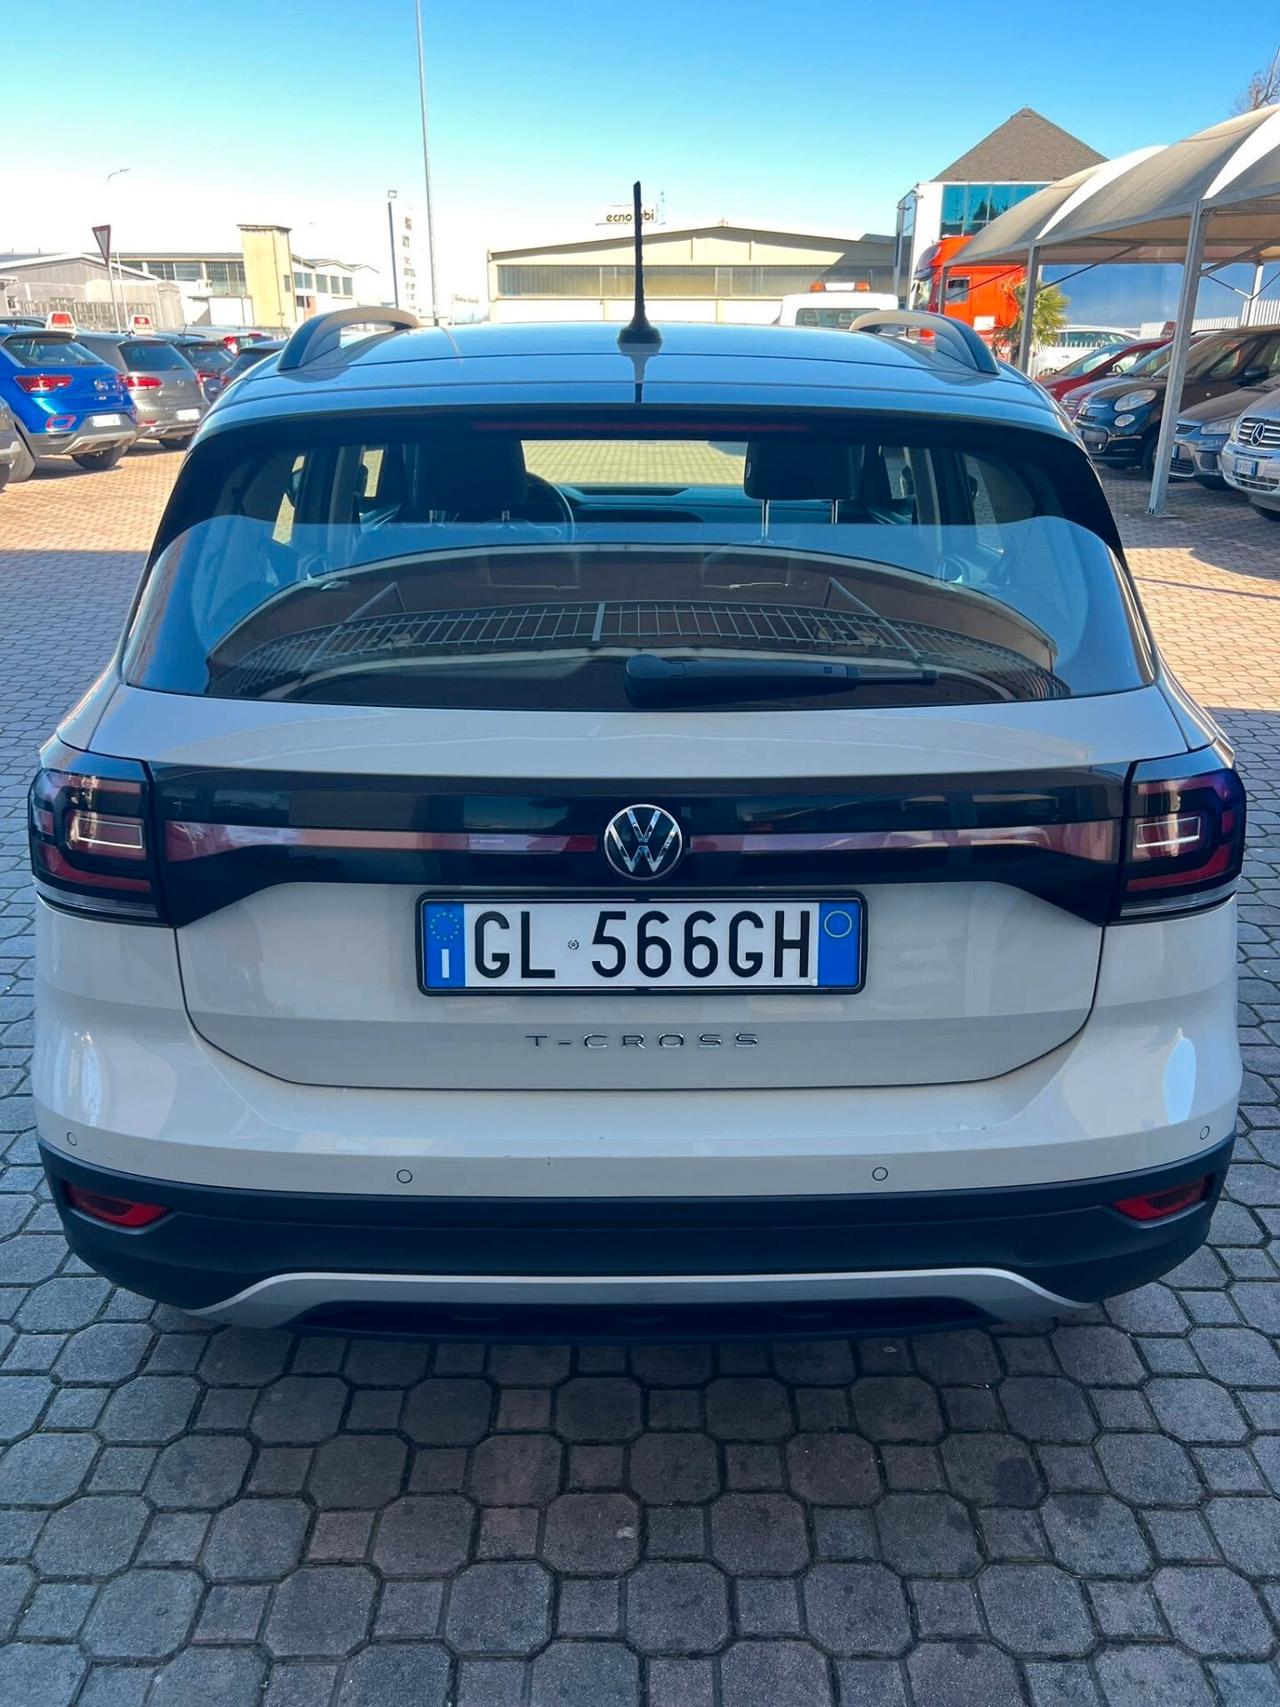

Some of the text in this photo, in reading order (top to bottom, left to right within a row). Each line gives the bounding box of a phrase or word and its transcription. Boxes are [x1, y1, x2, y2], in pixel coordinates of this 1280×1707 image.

[474, 910, 556, 979] GL
[591, 910, 811, 979] 566GH
[525, 1033, 759, 1049] T-CROSS
